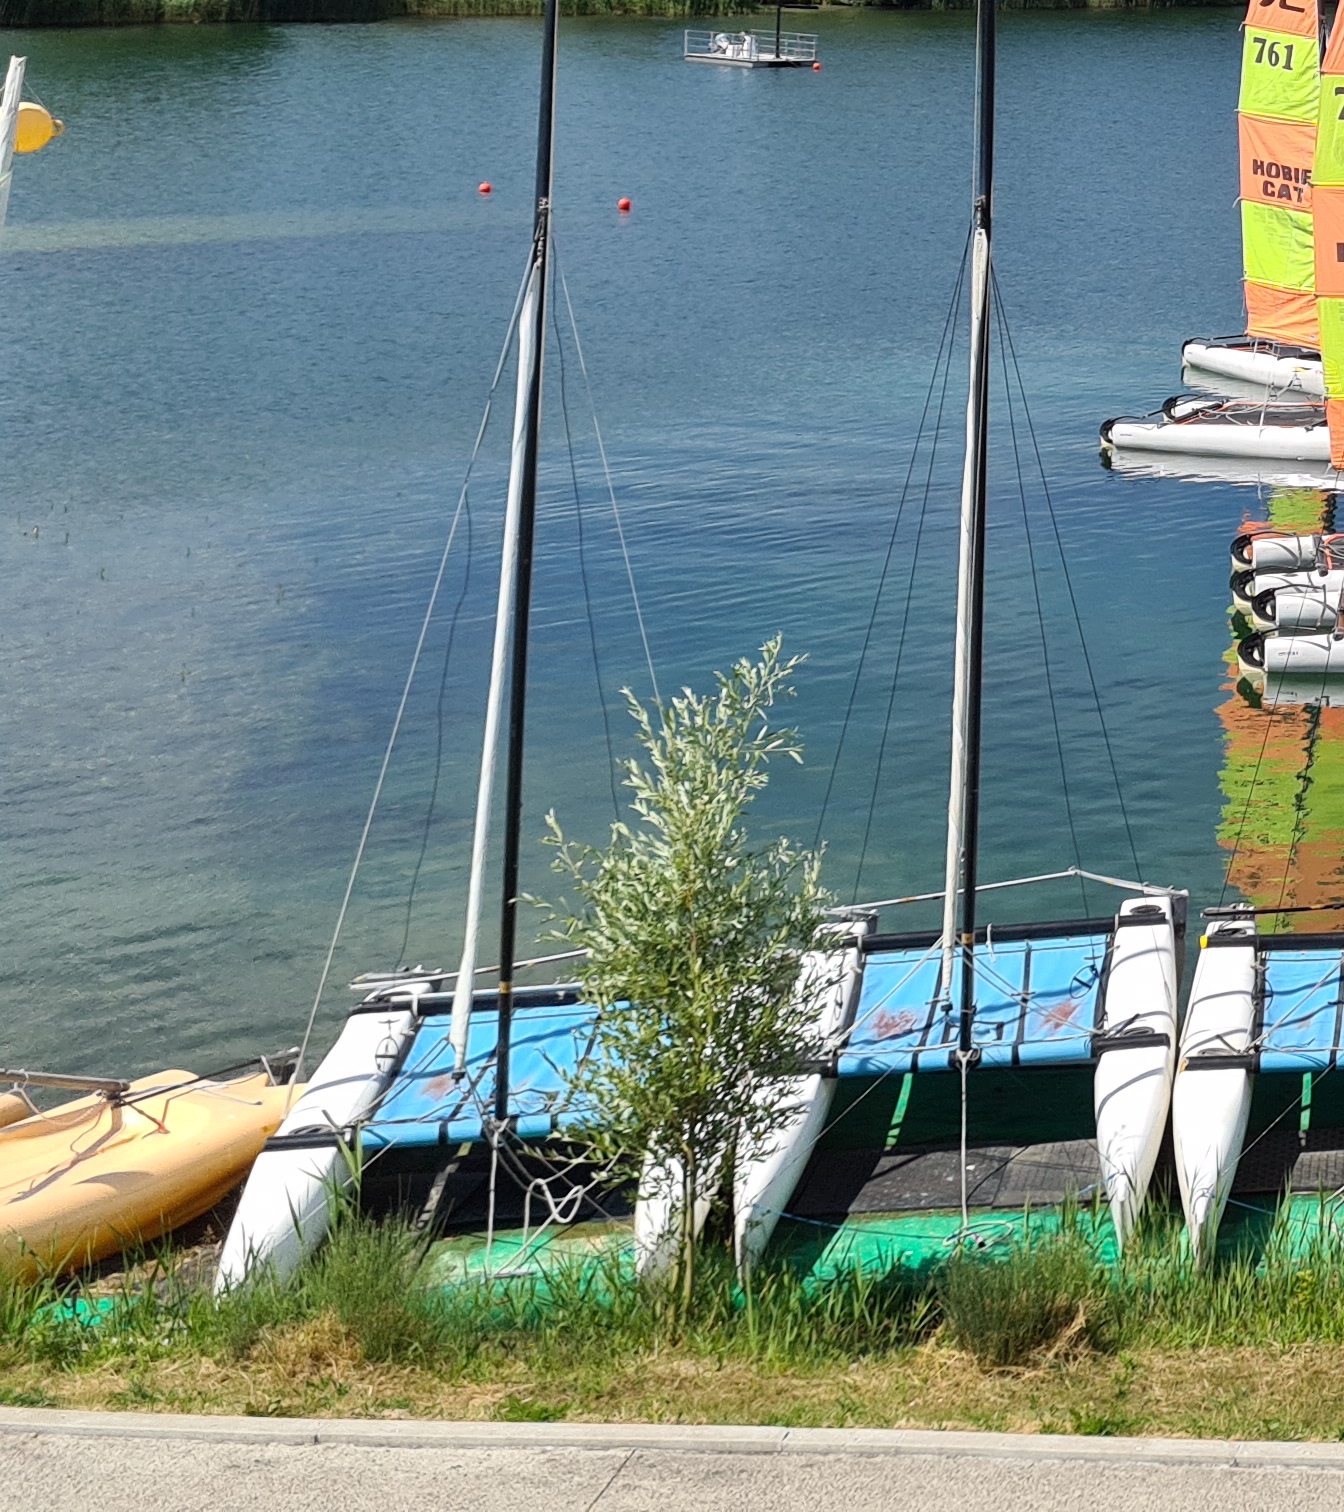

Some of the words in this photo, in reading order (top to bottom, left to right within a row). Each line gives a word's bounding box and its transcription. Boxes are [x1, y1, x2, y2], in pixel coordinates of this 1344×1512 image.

[1252, 36, 1295, 71] 761
[1252, 158, 1313, 186] HOBIE
[1262, 179, 1304, 204] CAT
